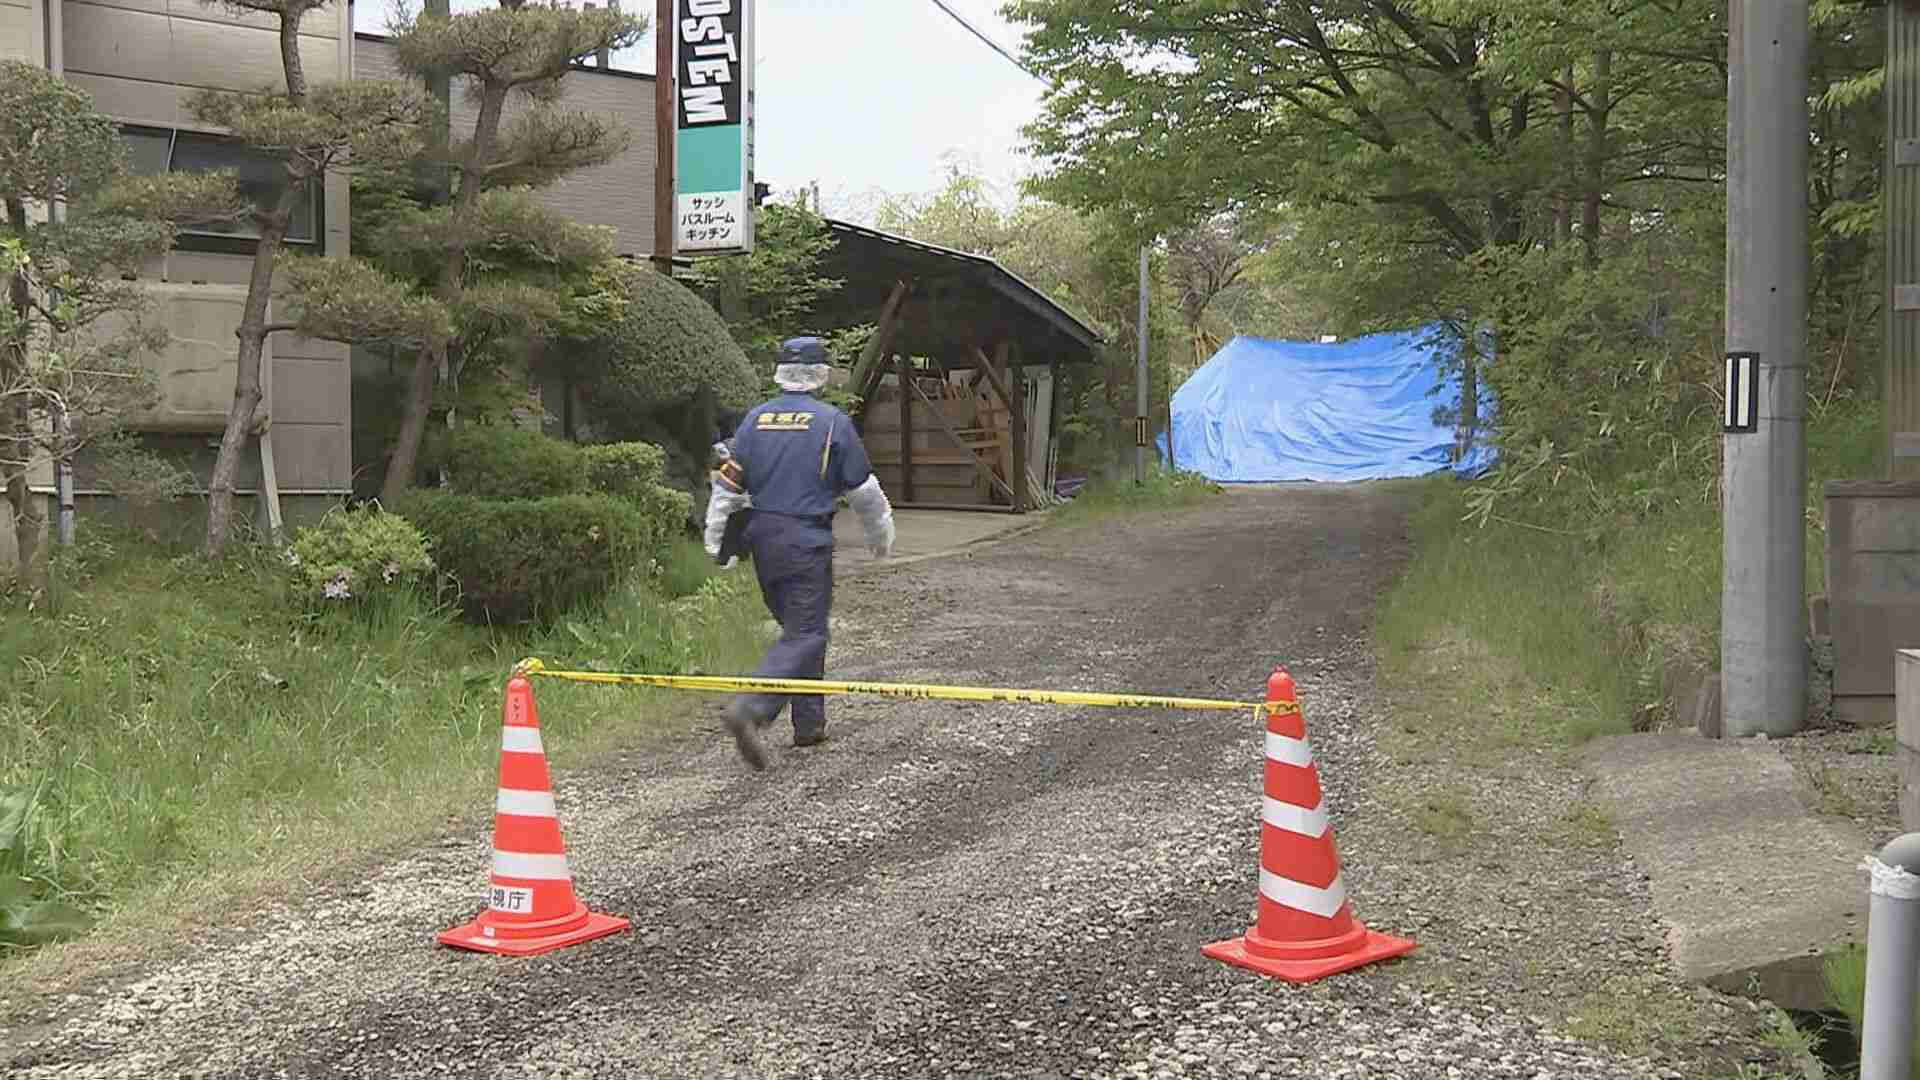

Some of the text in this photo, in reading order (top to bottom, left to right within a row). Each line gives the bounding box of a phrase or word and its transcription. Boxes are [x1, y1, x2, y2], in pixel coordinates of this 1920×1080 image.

[693, 197, 724, 210] サッシ
[681, 211, 735, 226] バスルーム
[686, 227, 730, 240] キッチン
